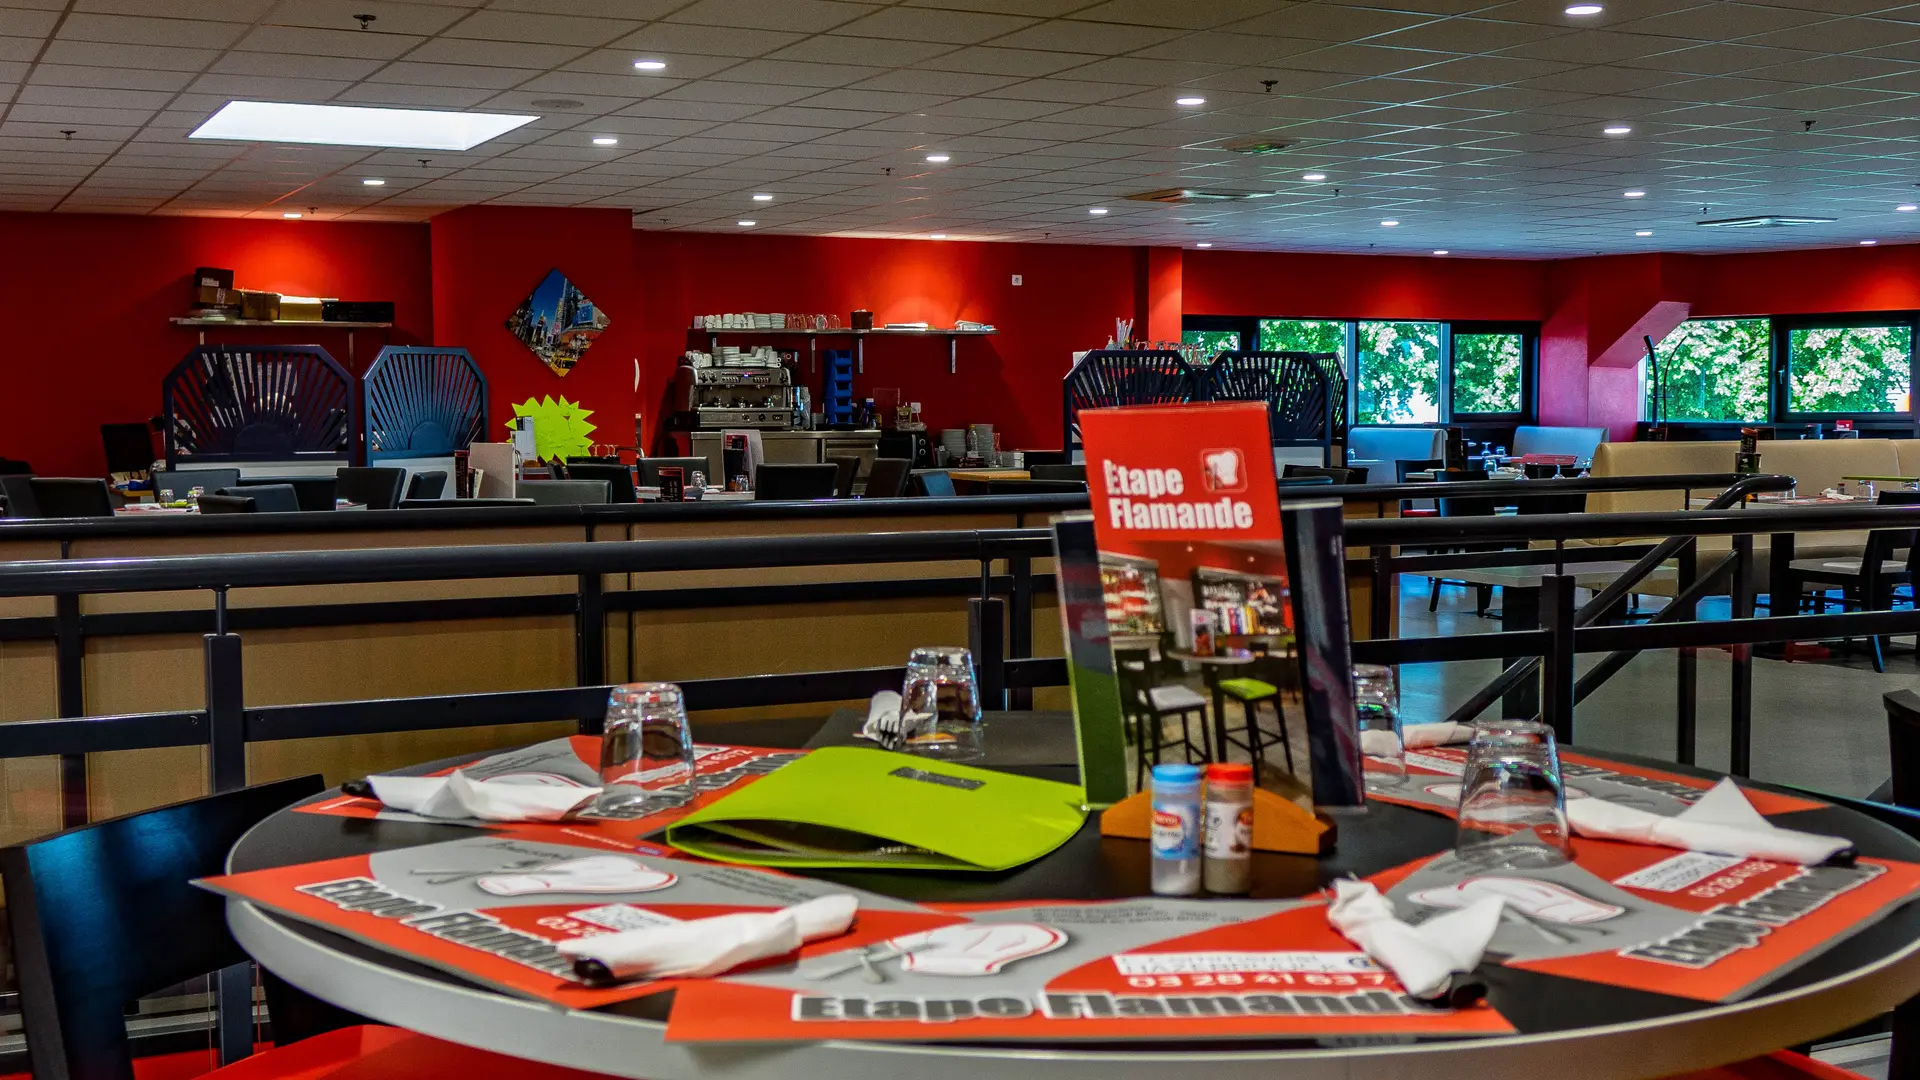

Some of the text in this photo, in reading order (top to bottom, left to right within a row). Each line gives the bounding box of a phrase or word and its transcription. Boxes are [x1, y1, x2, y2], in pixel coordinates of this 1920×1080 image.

[1103, 459, 1184, 498] Etape
[1109, 497, 1253, 529] Flamande
[1128, 975, 1182, 988] 03
